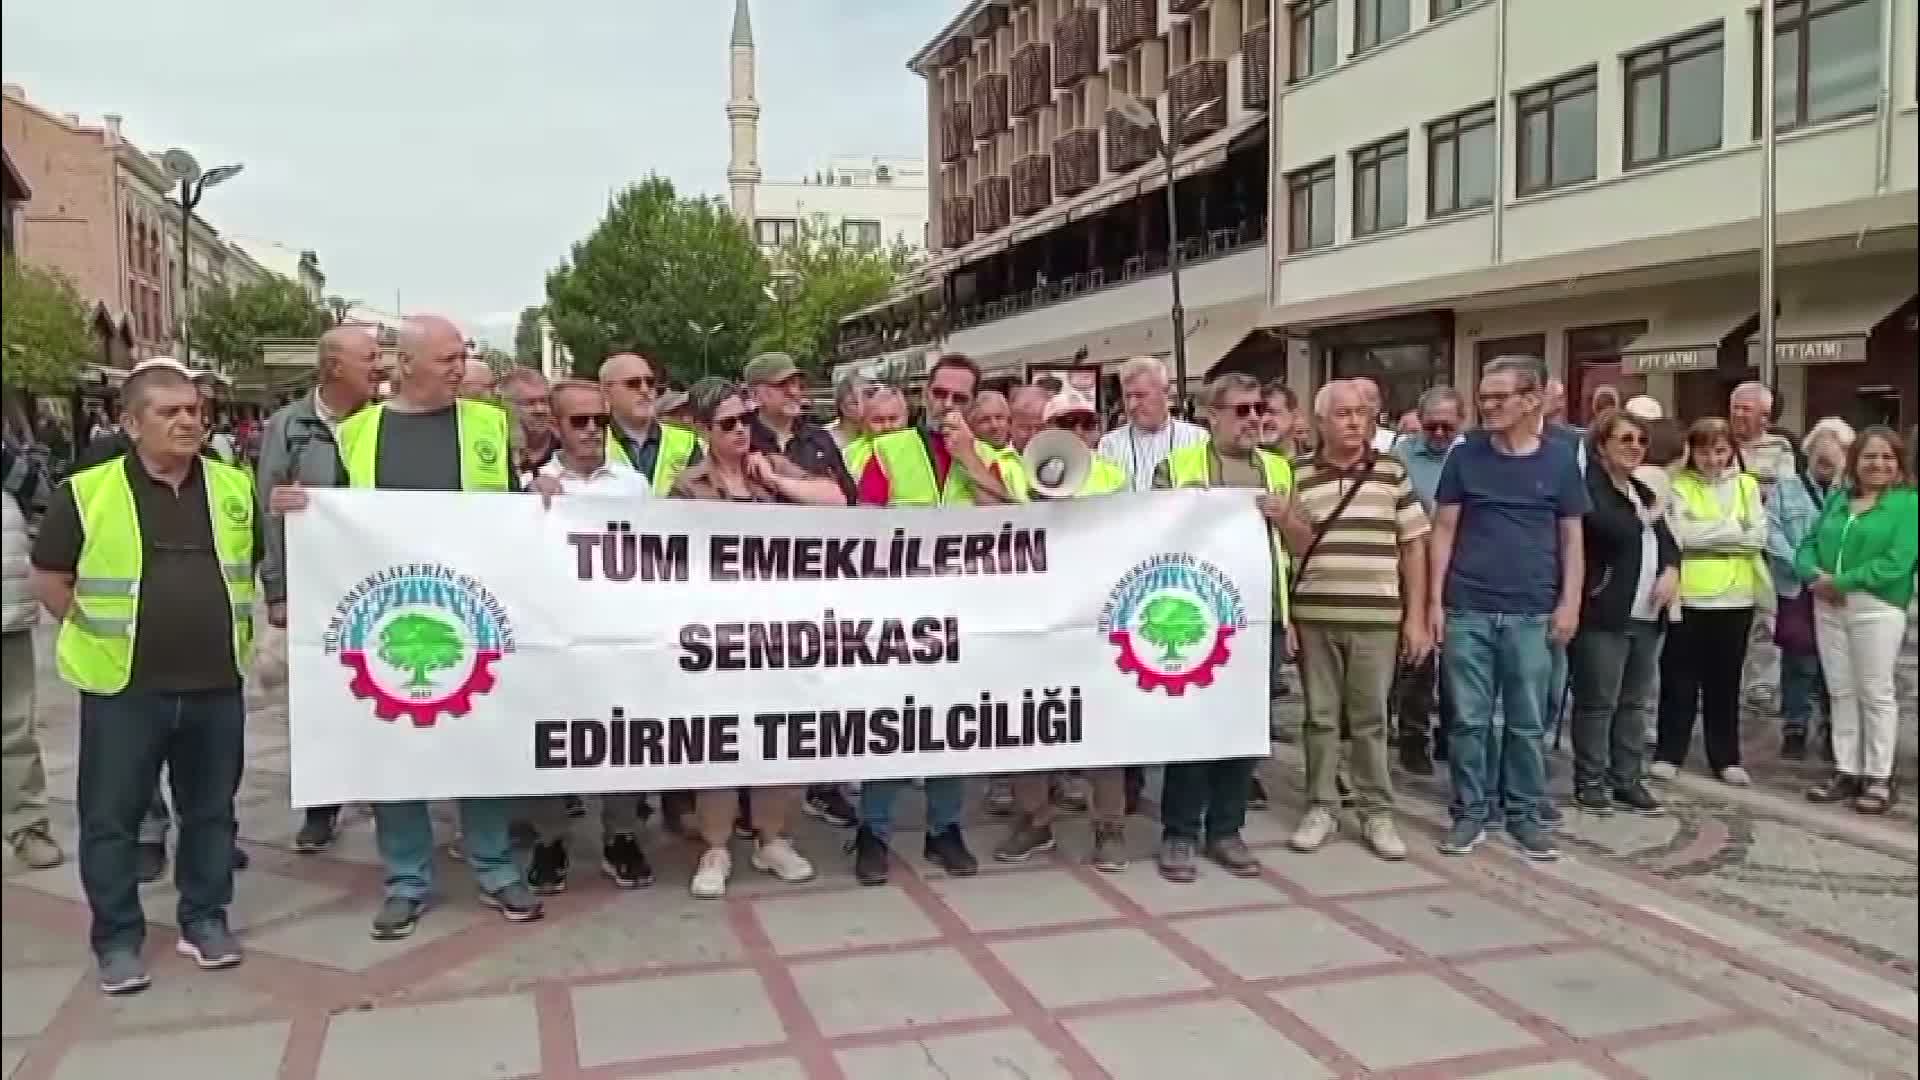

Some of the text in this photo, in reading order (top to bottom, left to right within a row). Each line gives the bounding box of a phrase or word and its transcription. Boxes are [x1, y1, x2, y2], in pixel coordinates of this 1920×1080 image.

[568, 521, 1048, 582] TÜM EMEKLİLERİN
[679, 609, 960, 672] SENDİKASI
[534, 686, 1083, 769] EDİRNE TEMSİLCİLİĞİ
